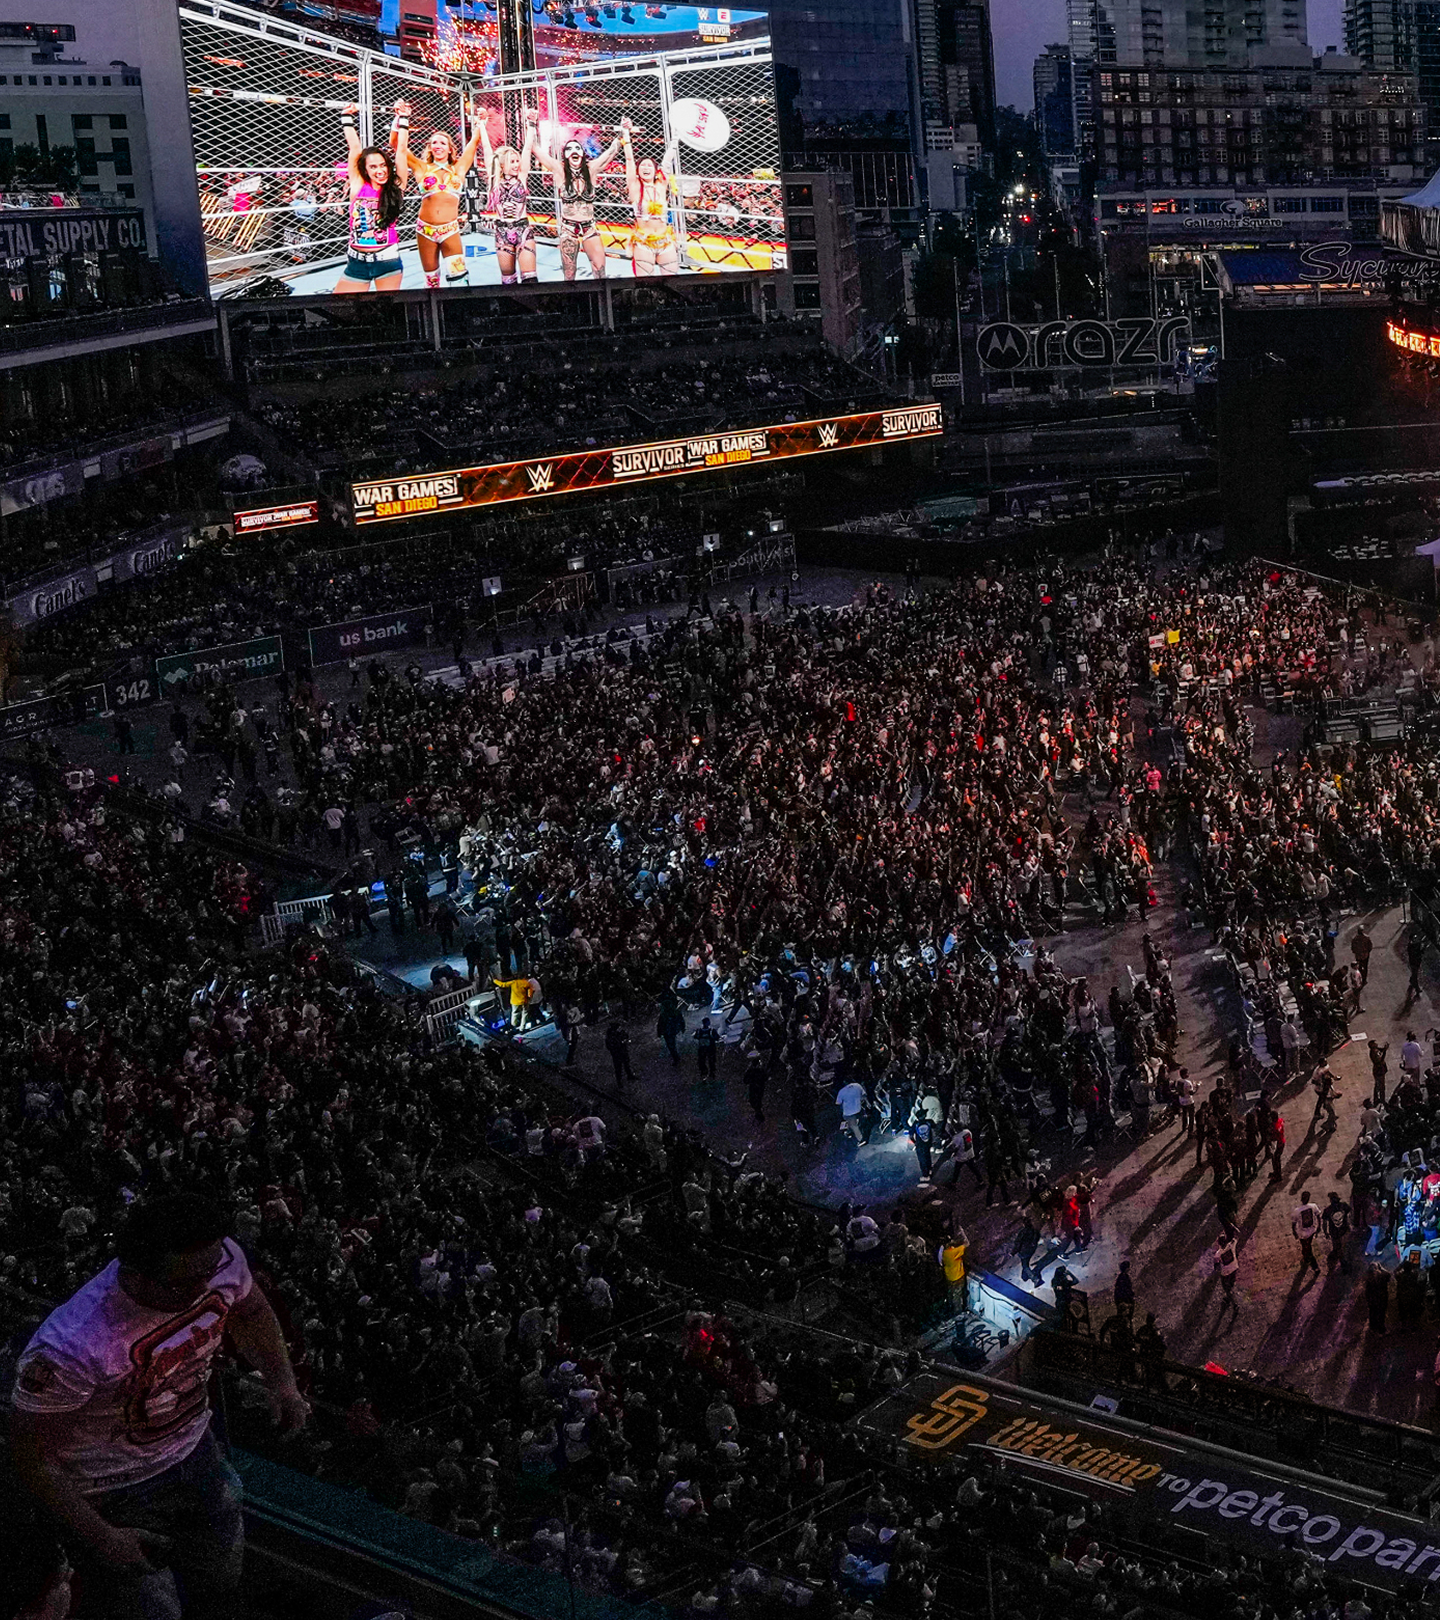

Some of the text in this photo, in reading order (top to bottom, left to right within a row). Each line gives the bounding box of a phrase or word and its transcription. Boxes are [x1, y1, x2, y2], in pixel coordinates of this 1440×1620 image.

[43, 218, 110, 252] SUPPLY
[117, 217, 146, 248] CO.
[1184, 217, 1283, 230] Gallagher Square
[1033, 316, 1190, 370] razr
[882, 410, 937, 435] SURVIVOR
[612, 433, 764, 475] SURVIVOR WAR GAMES
[705, 452, 724, 465] SAN
[727, 450, 752, 463] DIEGO
[354, 479, 453, 505] WAR GAMES
[375, 496, 438, 517] SAN DIEGO
[131, 537, 175, 575] Canel's
[32, 576, 86, 618] Canel's
[339, 621, 408, 647] us bank
[115, 678, 151, 705] 342
[985, 1417, 1164, 1489] Welcome
[1157, 1472, 1191, 1494] TO
[1171, 1475, 1342, 1544] petco
